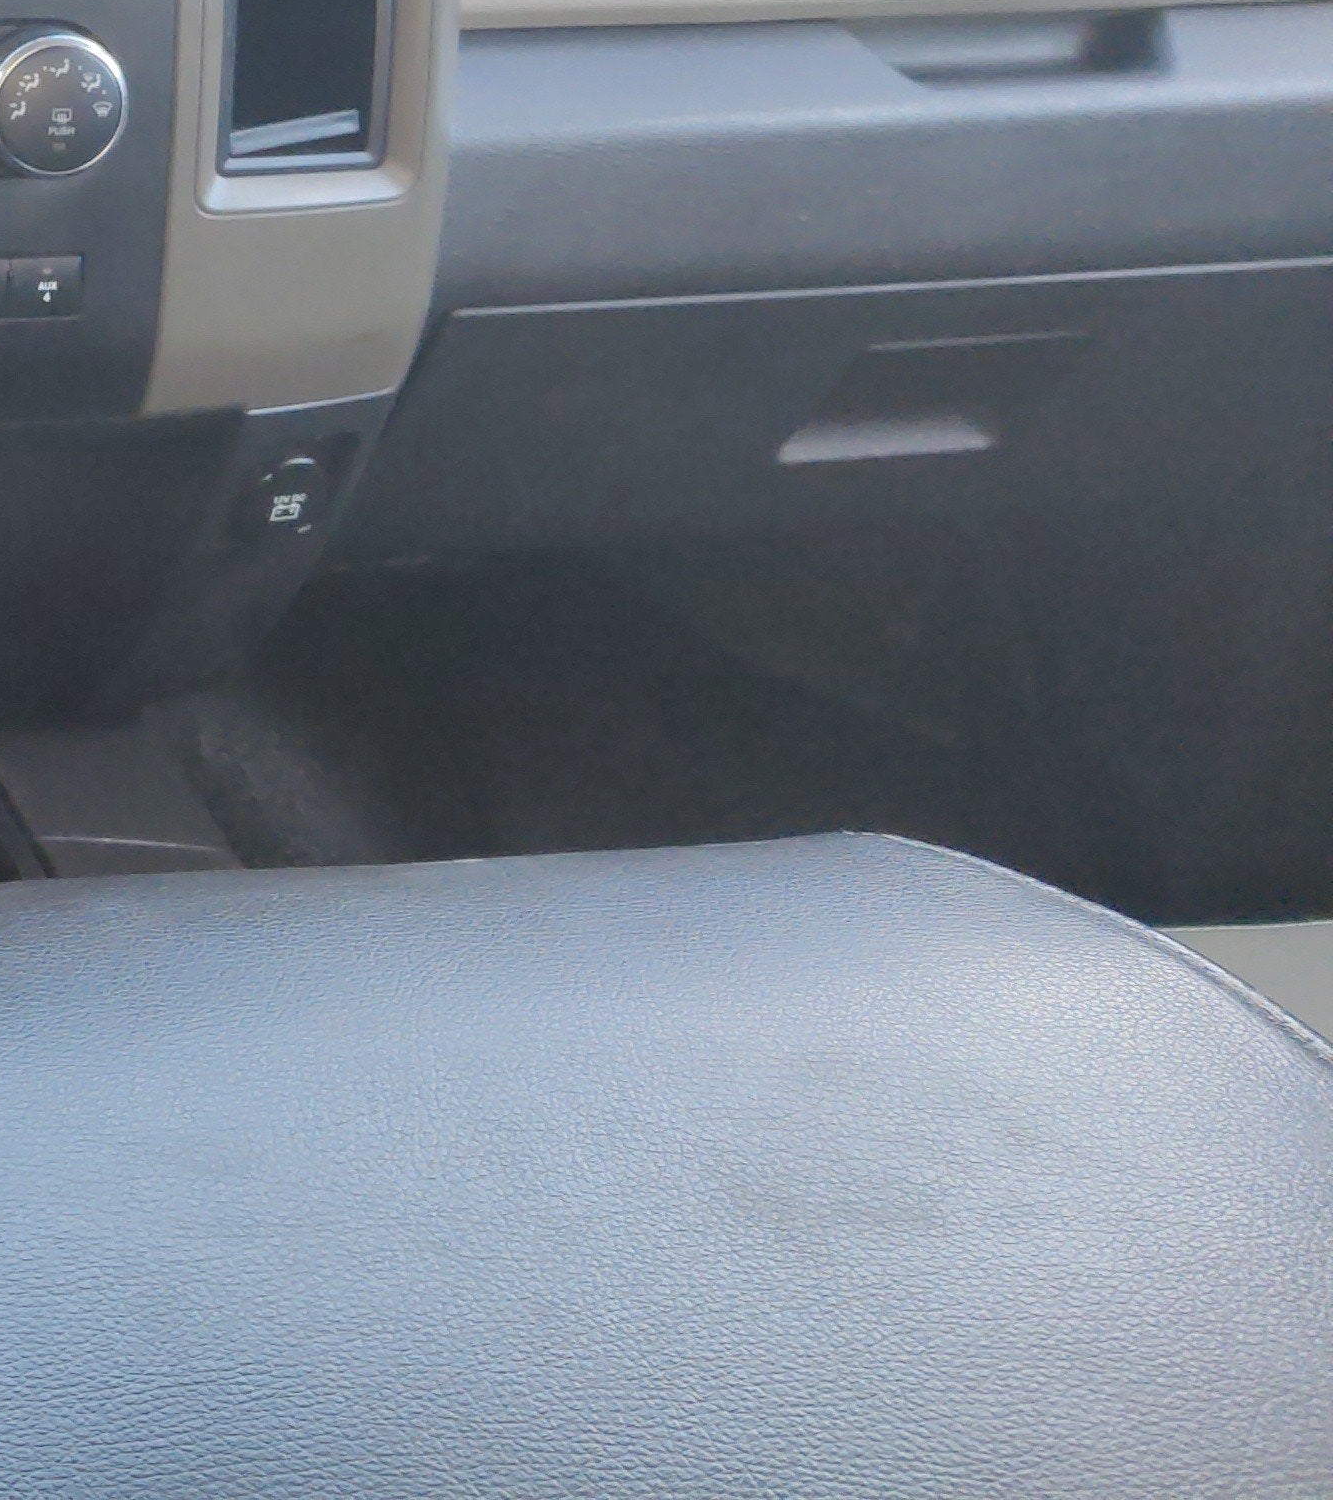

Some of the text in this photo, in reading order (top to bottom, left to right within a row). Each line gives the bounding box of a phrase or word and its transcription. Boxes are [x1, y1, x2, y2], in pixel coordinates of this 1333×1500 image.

[48, 125, 76, 137] PUSH
[37, 280, 58, 291] AUX
[42, 291, 52, 304] 4
